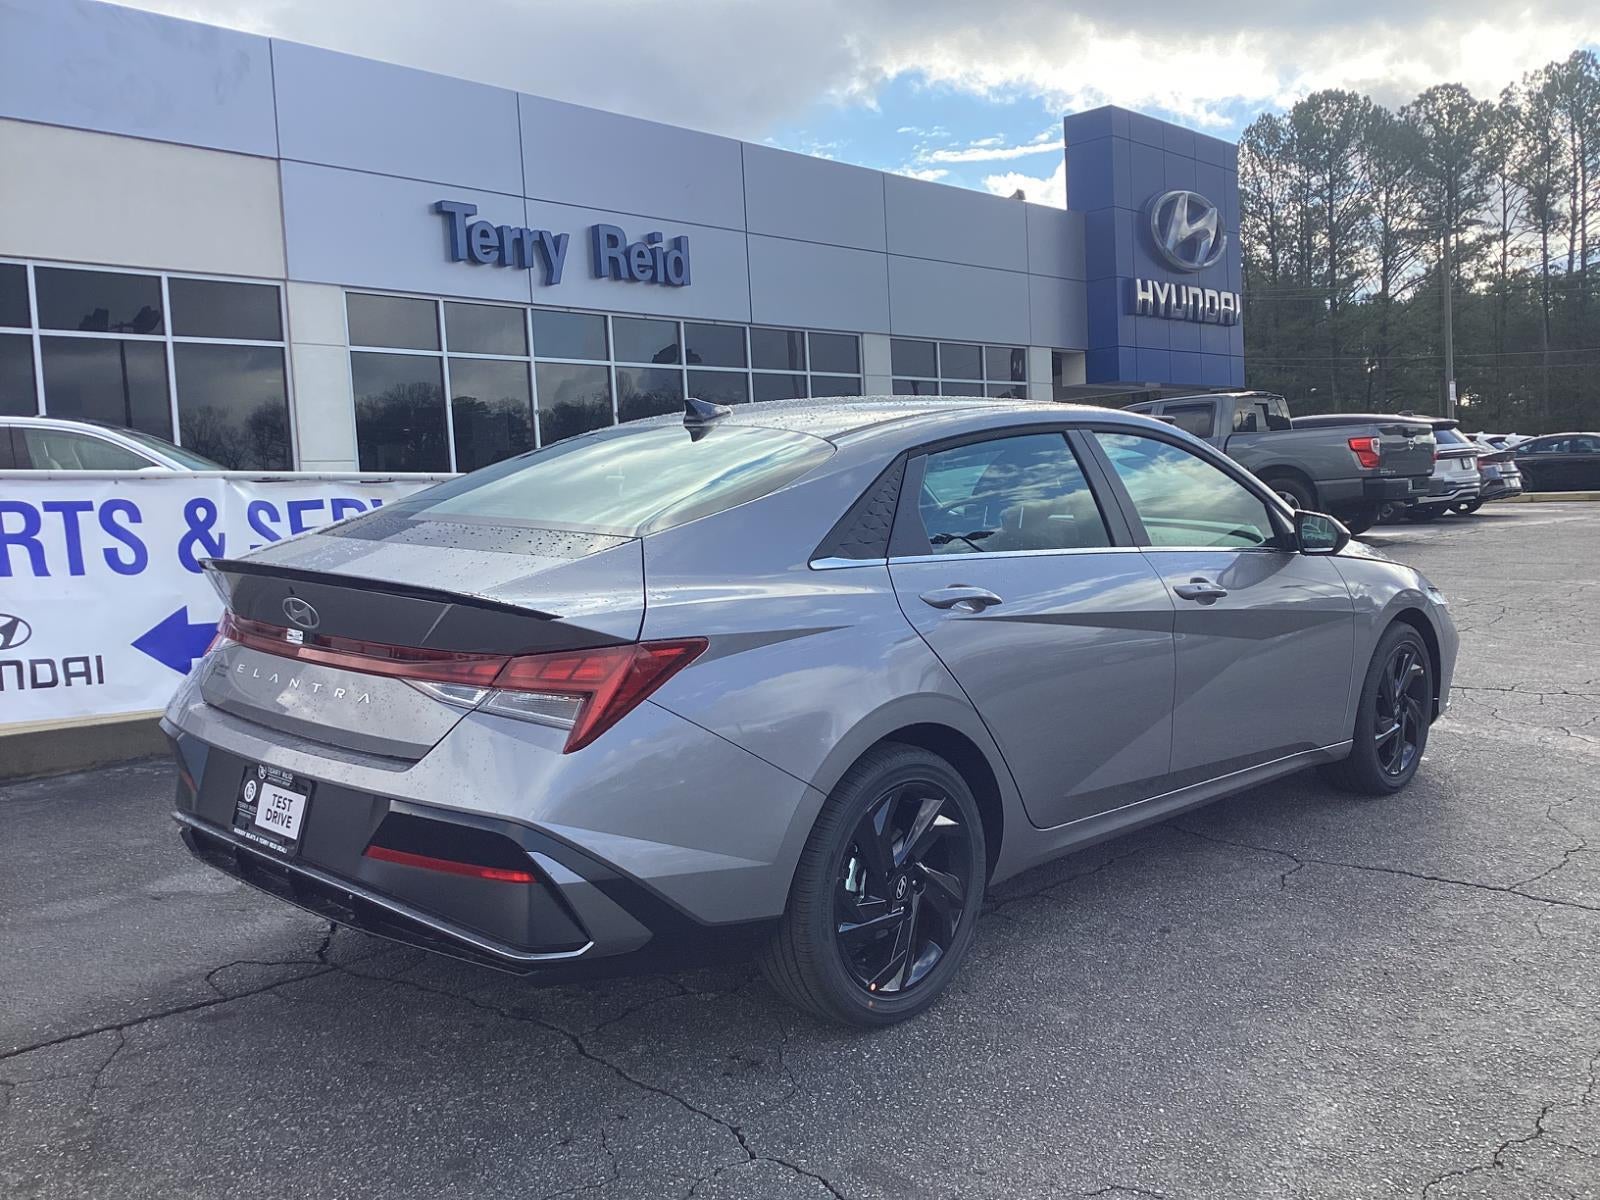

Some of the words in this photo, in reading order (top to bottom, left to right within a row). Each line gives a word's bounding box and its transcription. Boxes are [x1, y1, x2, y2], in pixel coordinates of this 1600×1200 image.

[434, 200, 570, 285] Terry
[590, 223, 691, 286] Reid
[1135, 278, 1241, 325] HYUNDAI
[178, 497, 226, 574] &
[236, 663, 371, 704] ELANTRA
[265, 808, 292, 829] DRIVE
[272, 793, 293, 812] TEST
